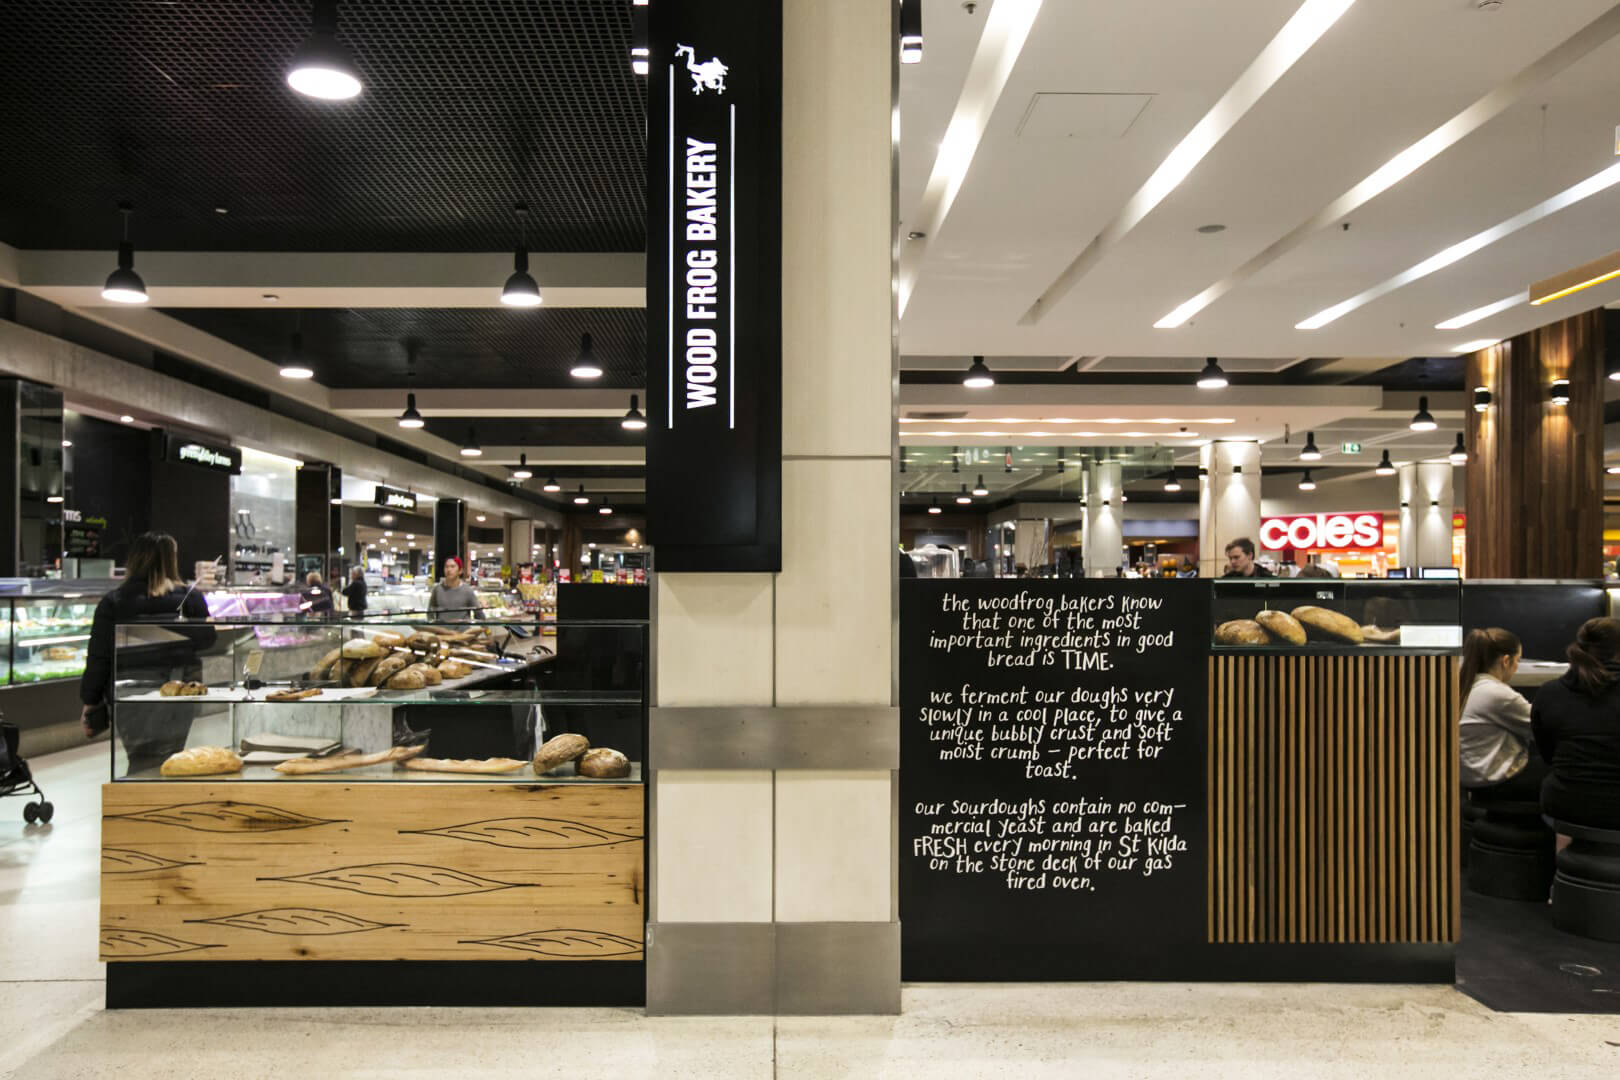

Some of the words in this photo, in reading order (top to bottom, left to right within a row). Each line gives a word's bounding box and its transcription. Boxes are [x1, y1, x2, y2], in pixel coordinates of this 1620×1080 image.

[686, 137, 718, 241] BAKERY
[686, 250, 718, 320] FROG
[686, 329, 718, 410] WOOD
[1260, 515, 1379, 550] coles
[942, 593, 970, 611] the
[978, 590, 1054, 617] woodfrog
[1061, 594, 1114, 613] bakers
[963, 611, 1002, 630] that
[1008, 616, 1035, 630] one
[1043, 610, 1060, 629] of
[1067, 611, 1094, 630] the
[1102, 611, 1142, 630] most
[930, 630, 1014, 653] important
[1020, 629, 1110, 652] ingredients
[1117, 629, 1131, 647] in
[1136, 631, 1174, 654] good
[987, 650, 1035, 667] bread
[1042, 651, 1055, 665] is
[1061, 649, 1114, 671] TIME.
[931, 691, 953, 704] we
[960, 684, 1029, 704] ferment
[1035, 690, 1065, 703] our
[1071, 686, 1128, 709] doughs
[1135, 688, 1174, 708] very
[919, 707, 973, 727] slowly
[978, 705, 992, 722] in
[998, 711, 1009, 722] a
[1016, 707, 1047, 725] cool
[1053, 708, 1101, 727] place,
[1110, 704, 1128, 723] to
[1135, 703, 1165, 728] give
[1172, 710, 1183, 721] a
[929, 723, 984, 745] unique
[992, 725, 1044, 745] bubbly
[1050, 722, 1096, 742] crust
[1102, 723, 1132, 741] and
[1138, 723, 1174, 742] soft
[940, 742, 984, 760] moist
[990, 744, 1040, 761] crumb
[1068, 741, 1130, 763] perfect
[1137, 741, 1164, 760] for
[1026, 760, 1077, 780] toast.
[915, 802, 945, 815] our
[951, 798, 1045, 821] sourdoughs
[1052, 797, 1111, 816] contain
[1118, 801, 1136, 814] no
[931, 815, 991, 837] mercial
[997, 816, 1046, 838] yeast
[1052, 816, 1082, 833] and
[1088, 820, 1118, 834] are
[1124, 816, 1171, 837] baked
[913, 835, 967, 858] FRESH
[974, 837, 1023, 857] every
[1028, 834, 1091, 858] morning
[1100, 834, 1112, 851] in
[1118, 833, 1142, 857] St
[929, 858, 948, 870] on
[956, 854, 984, 874] the
[990, 853, 1035, 872] stone
[1042, 854, 1077, 873] deck
[1085, 851, 1102, 870] of
[1108, 857, 1138, 870] our
[1143, 854, 1172, 876] gas
[1006, 871, 1046, 890] fired
[1052, 876, 1095, 891] oven.
